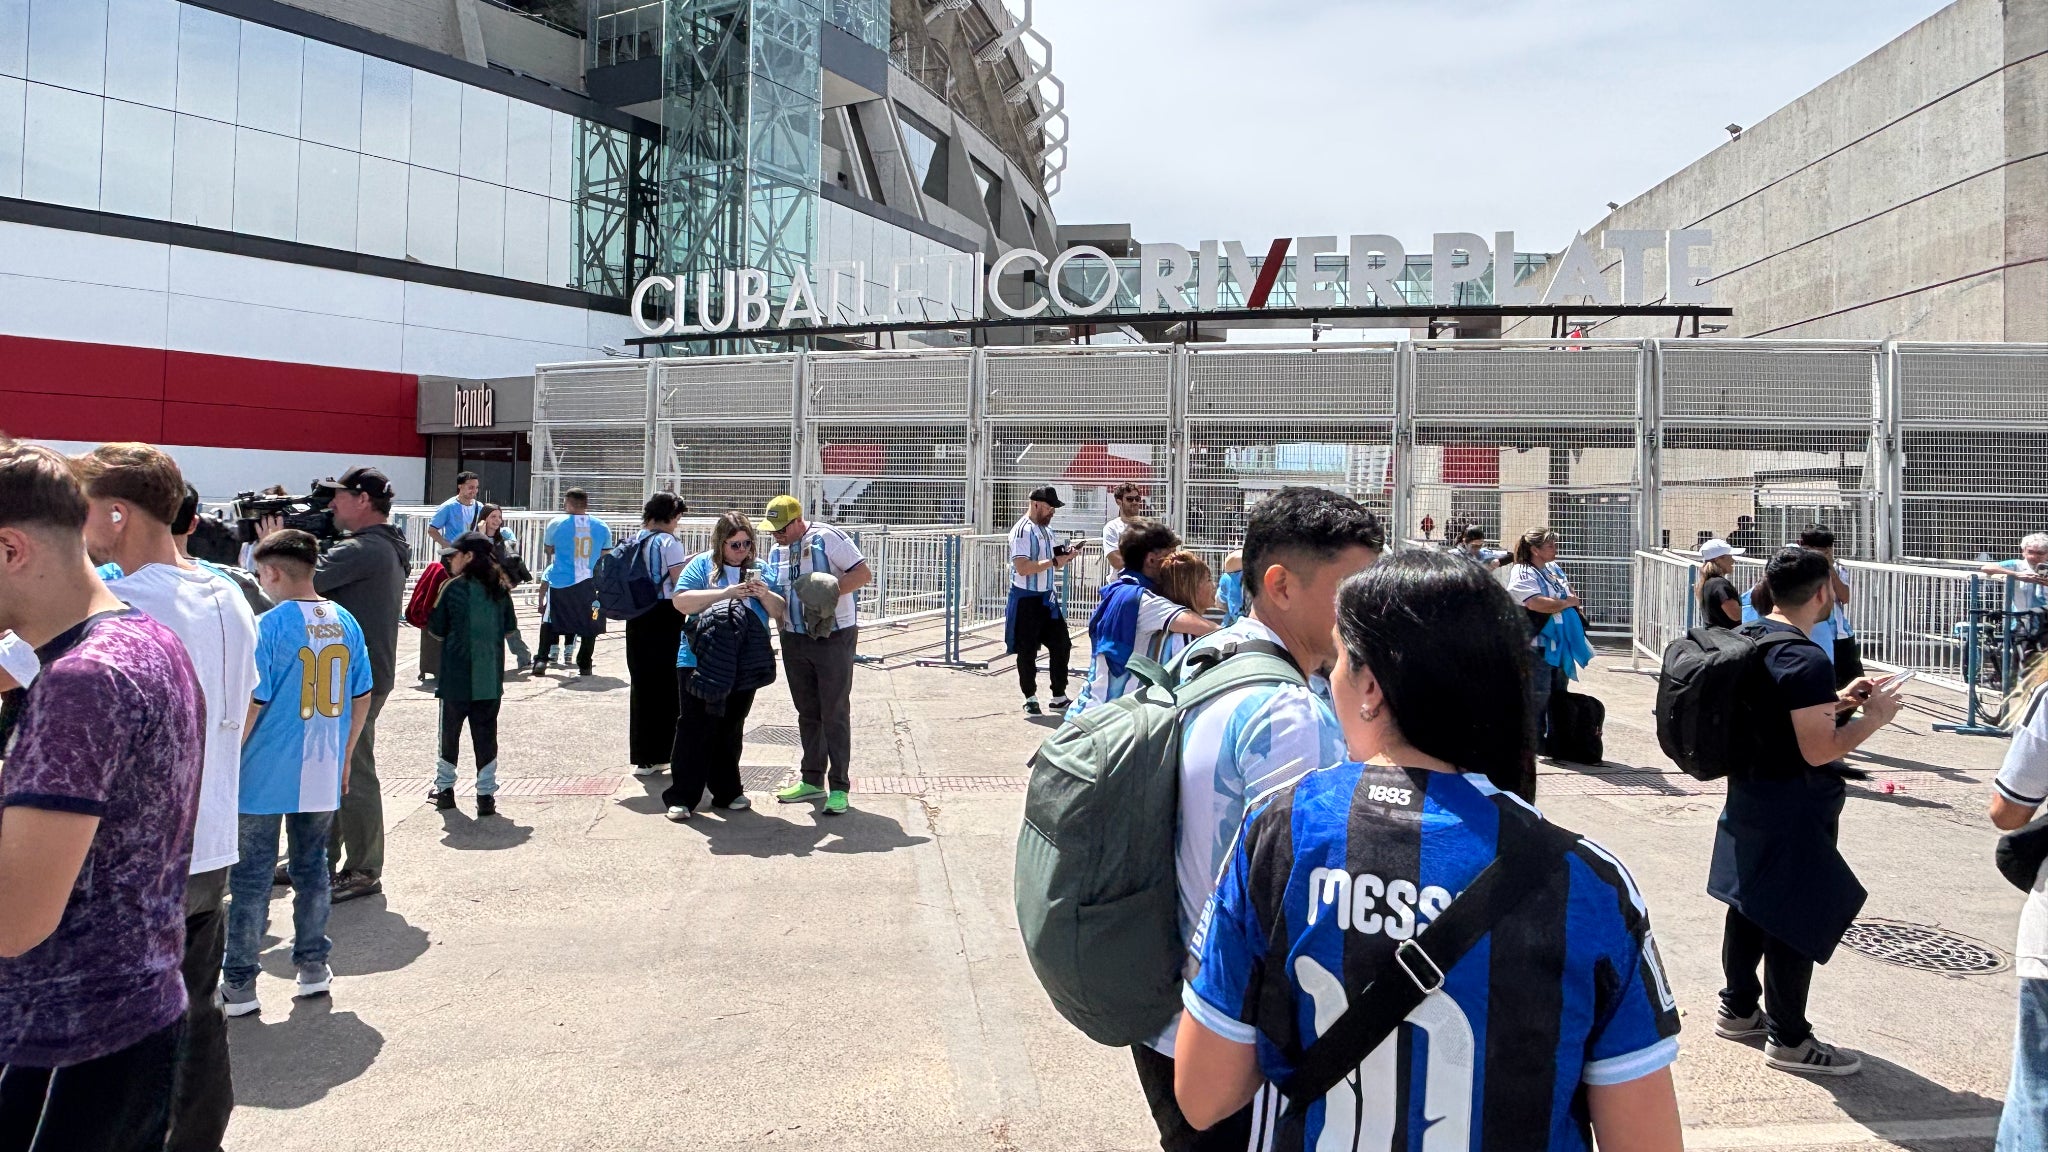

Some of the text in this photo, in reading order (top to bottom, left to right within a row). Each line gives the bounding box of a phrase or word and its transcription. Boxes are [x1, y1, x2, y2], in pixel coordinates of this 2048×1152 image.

[631, 229, 1712, 336] CLUB ATLETICO RIVER PLATE
[455, 382, 493, 427] banda
[298, 644, 350, 720] 10
[1368, 784, 1412, 806] 1893
[1307, 867, 1463, 940] MESS
